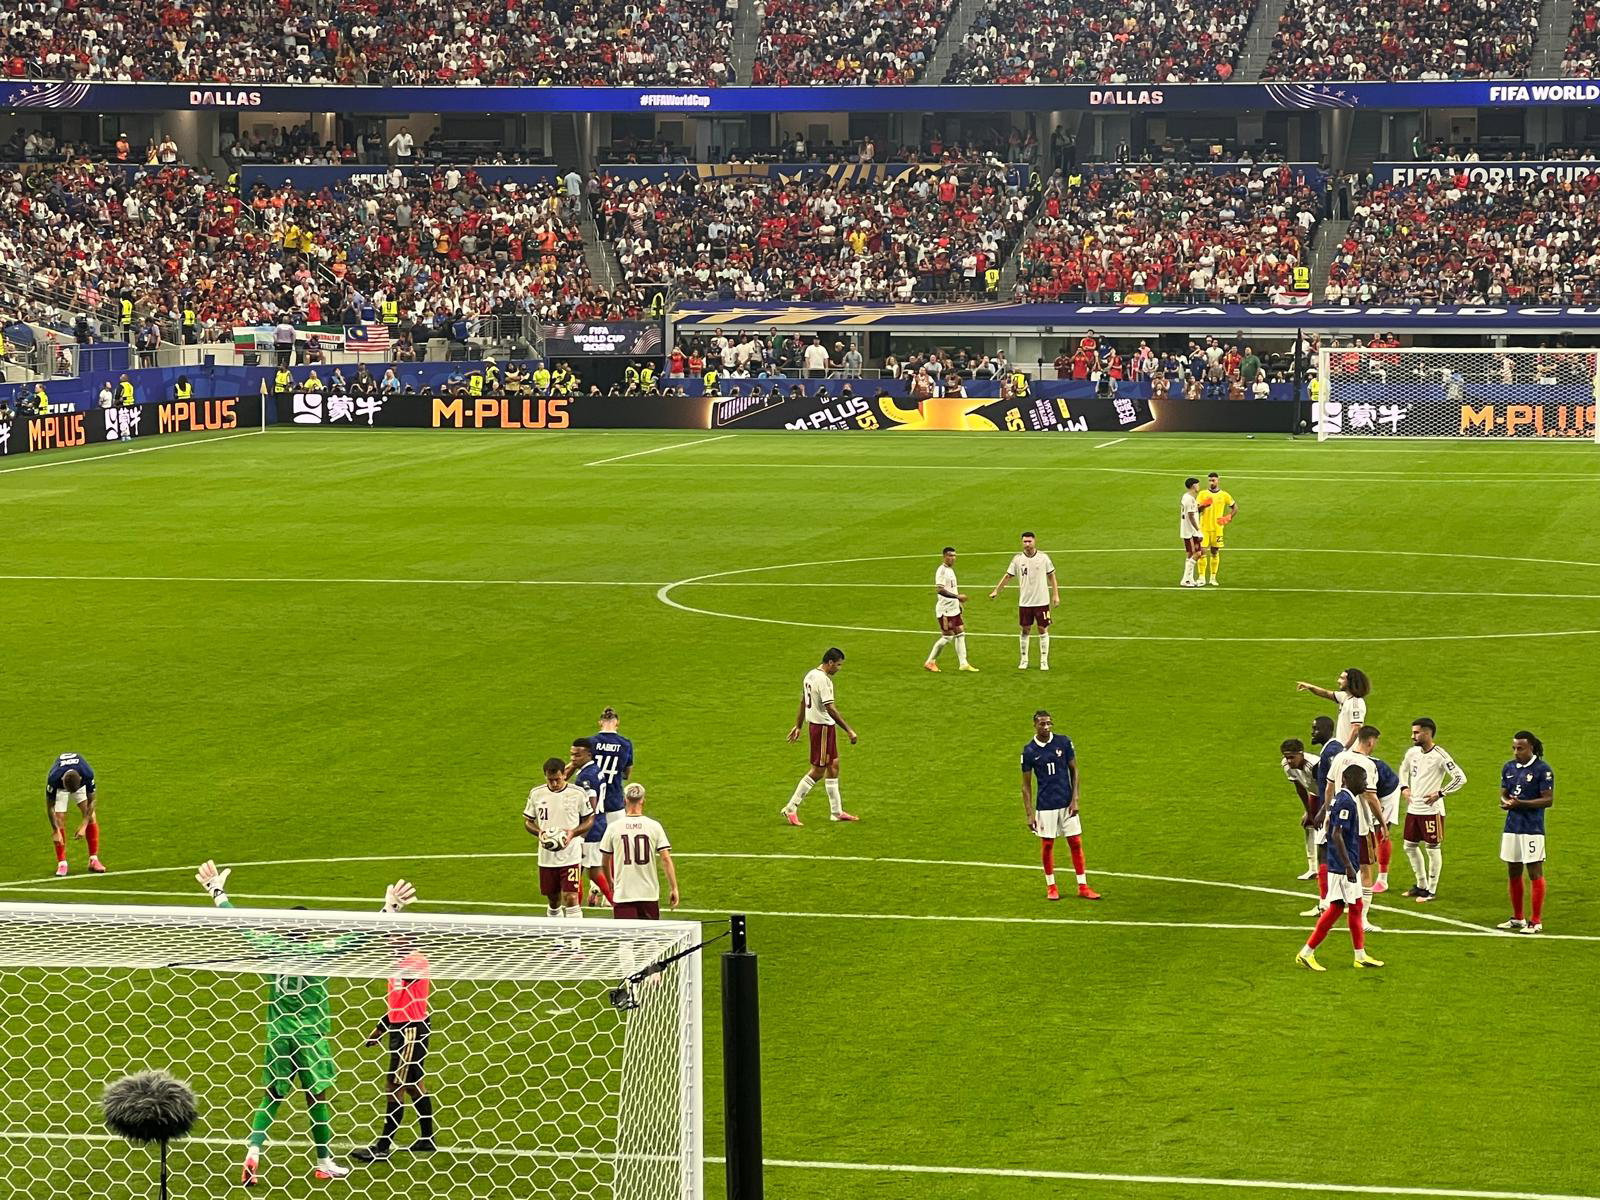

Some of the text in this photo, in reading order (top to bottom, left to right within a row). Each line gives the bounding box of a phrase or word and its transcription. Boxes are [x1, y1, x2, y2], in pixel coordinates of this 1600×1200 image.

[190, 91, 261, 105] DALLAS
[1090, 91, 1164, 104] DALLAS
[1490, 85, 1600, 101] FIFA WORLD
[640, 95, 711, 107] #FIFAWorldCup
[1076, 307, 1226, 315] FIFA
[1245, 307, 1508, 316] WORLD
[589, 326, 609, 335] FIFA
[573, 335, 625, 343] WORLD CUP
[327, 394, 383, 425] 蒙牛
[432, 398, 569, 429] M-PLUS
[158, 400, 237, 434] M-PLUS
[1348, 402, 1408, 433] 蒙牛
[28, 414, 86, 453] M-PLUS
[596, 742, 621, 753] RABIOT
[594, 754, 619, 784] 14
[1046, 762, 1056, 775] 11
[1513, 784, 1522, 795] 5
[538, 807, 549, 821] 21
[625, 822, 642, 830] OLMO
[1425, 820, 1436, 833] 15
[620, 834, 650, 865] 10
[1528, 840, 1536, 854] 5
[567, 867, 580, 882] 21
